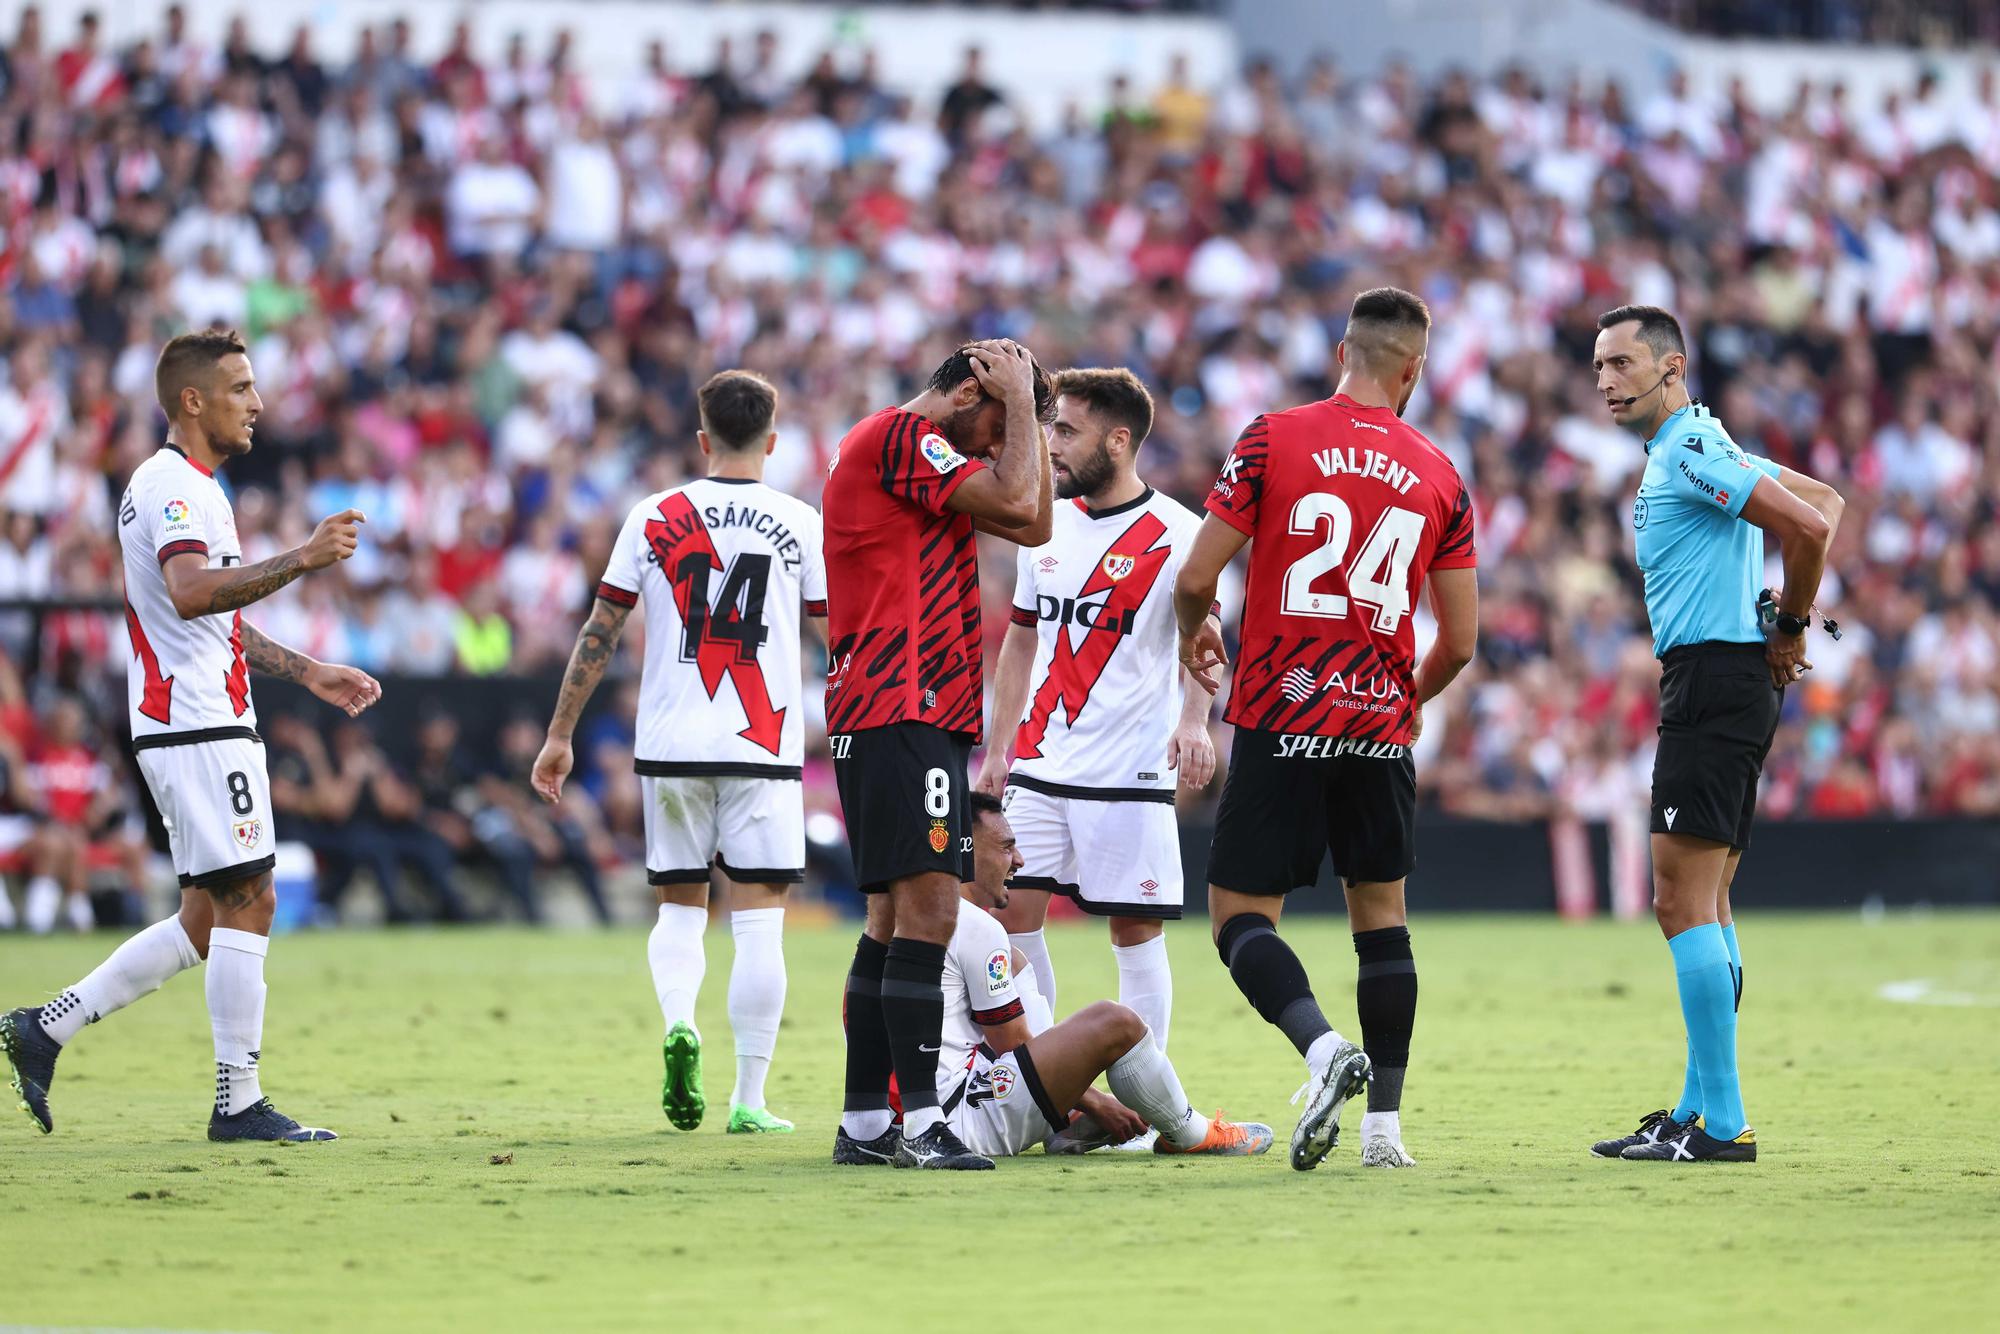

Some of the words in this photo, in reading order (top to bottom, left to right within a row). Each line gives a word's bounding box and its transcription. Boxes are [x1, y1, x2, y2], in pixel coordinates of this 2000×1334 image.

[1220, 453, 1243, 483] K
[1312, 447, 1421, 495] VALJENT
[1680, 460, 1715, 496] WÜRTH
[165, 523, 190, 532] LaLiga
[647, 511, 704, 568] SALVI
[705, 501, 801, 571] SÁNCHEZ
[1280, 492, 1427, 636] 24
[678, 551, 772, 666] 14
[1036, 593, 1137, 636] DIGI
[1322, 671, 1404, 701] ALUA
[1332, 699, 1362, 709] HOTELS
[1370, 703, 1398, 715] RESORTS
[226, 770, 254, 818] 8
[925, 767, 950, 818] 8
[990, 979, 1010, 991] LaLiga
